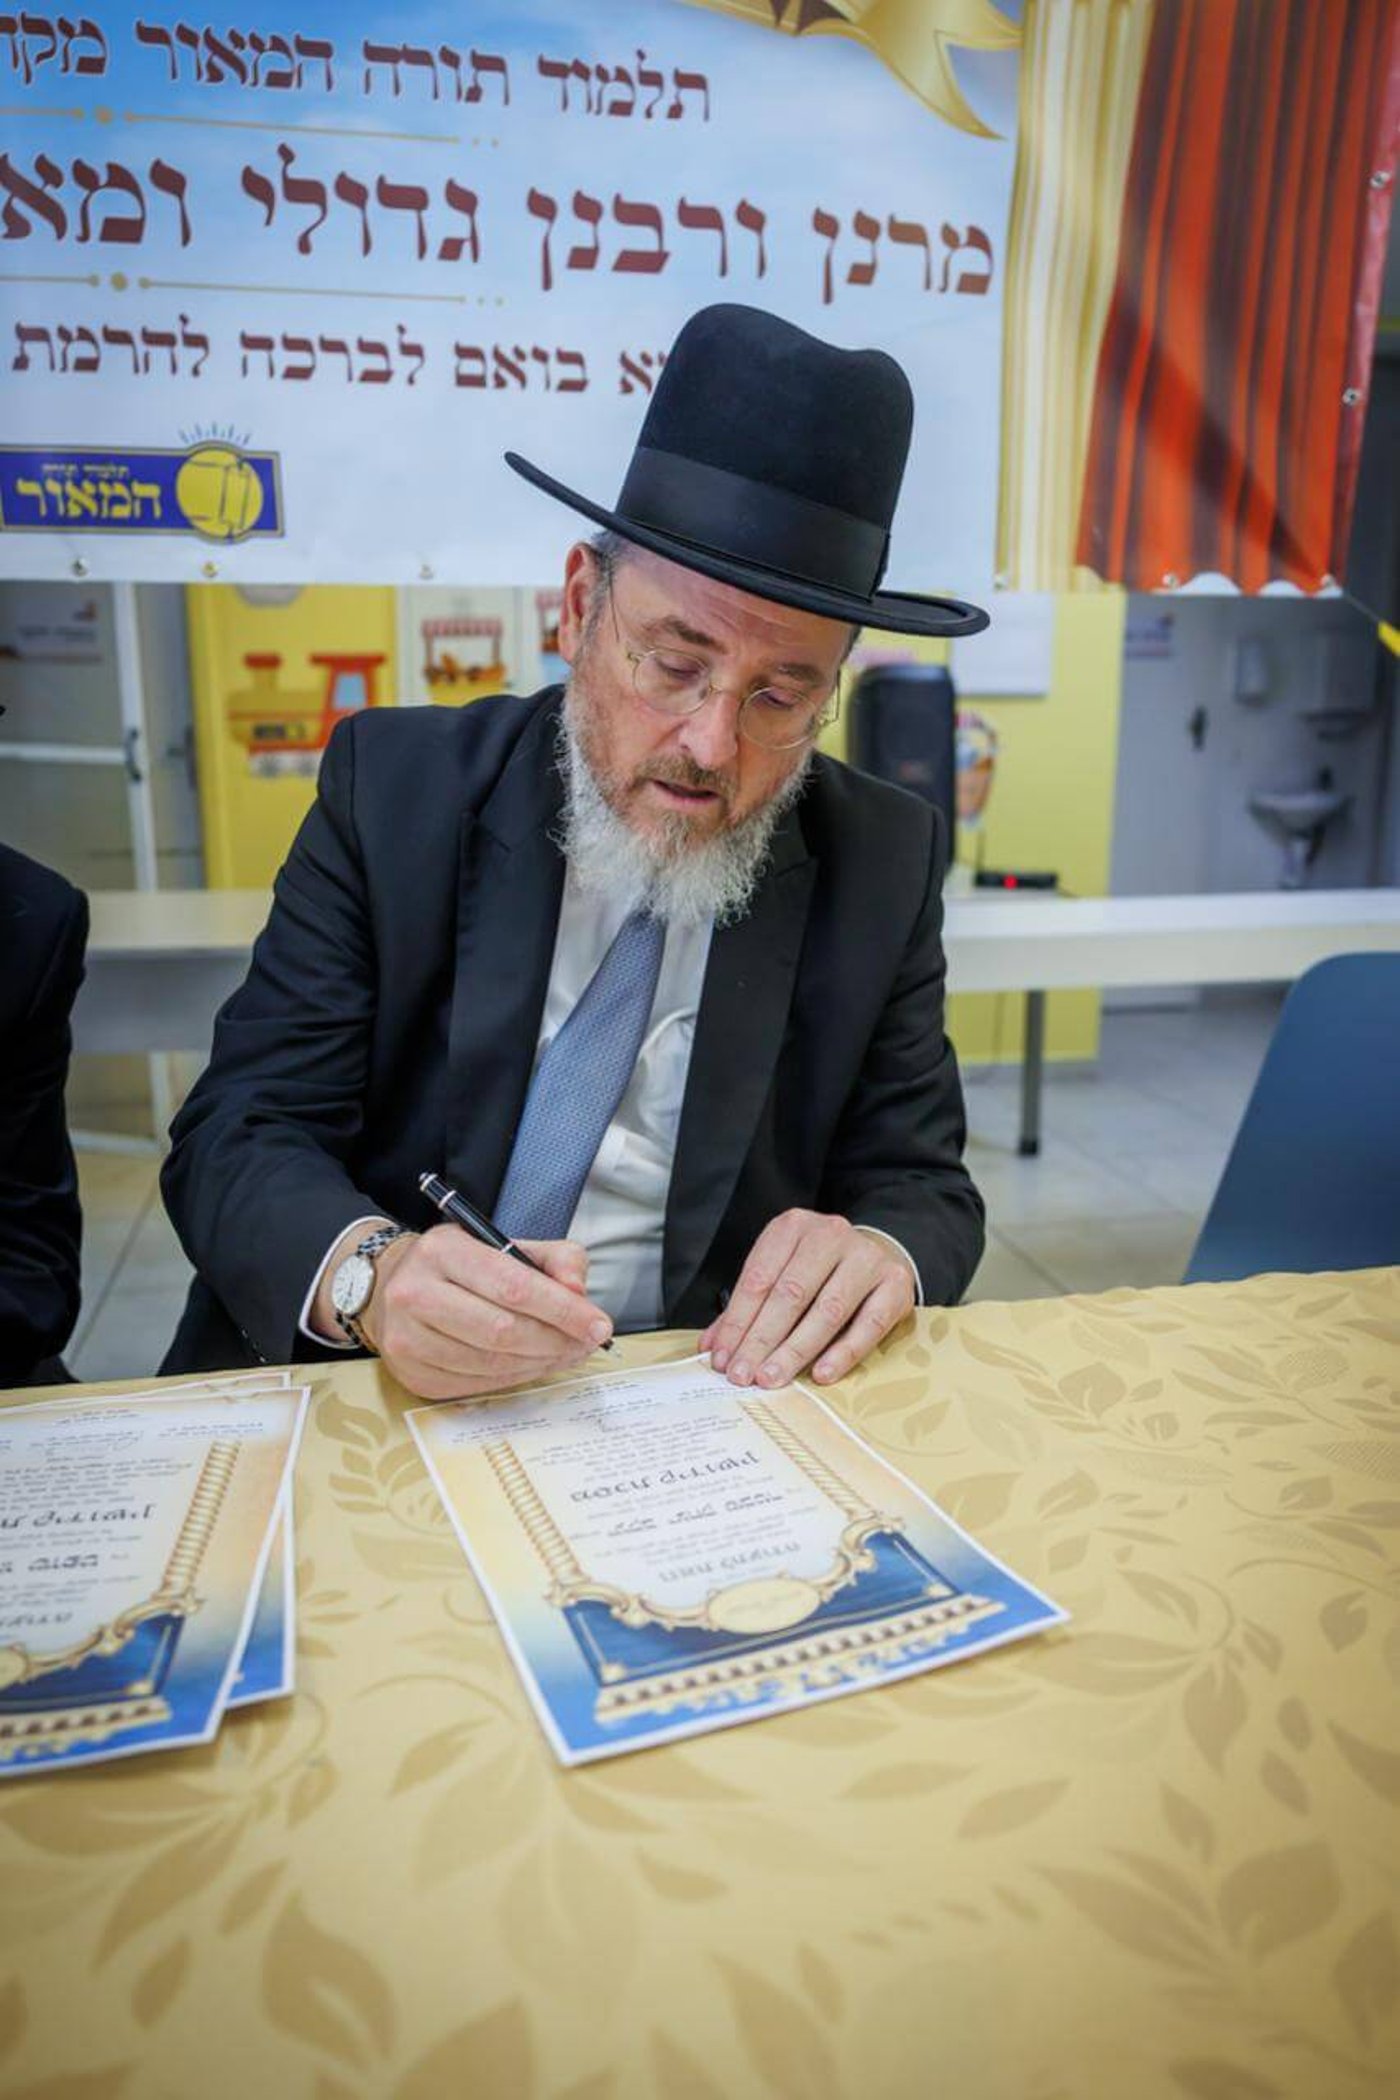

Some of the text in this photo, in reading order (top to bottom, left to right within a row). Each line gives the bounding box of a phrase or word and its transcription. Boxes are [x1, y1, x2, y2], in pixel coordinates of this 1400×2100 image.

[136, 21, 333, 89] המאור
[364, 42, 509, 103] תורה
[538, 50, 708, 119] תלמוד
[242, 143, 479, 263] גדולי
[527, 188, 766, 291] ורבנן
[813, 208, 992, 304] מרנן
[13, 314, 209, 377] להרמת
[241, 324, 424, 384] לברכה
[455, 343, 588, 392] בואם
[17, 477, 161, 518] המאור
[571, 1477, 653, 1502] מסכת
[660, 1450, 759, 1485] קידושין
